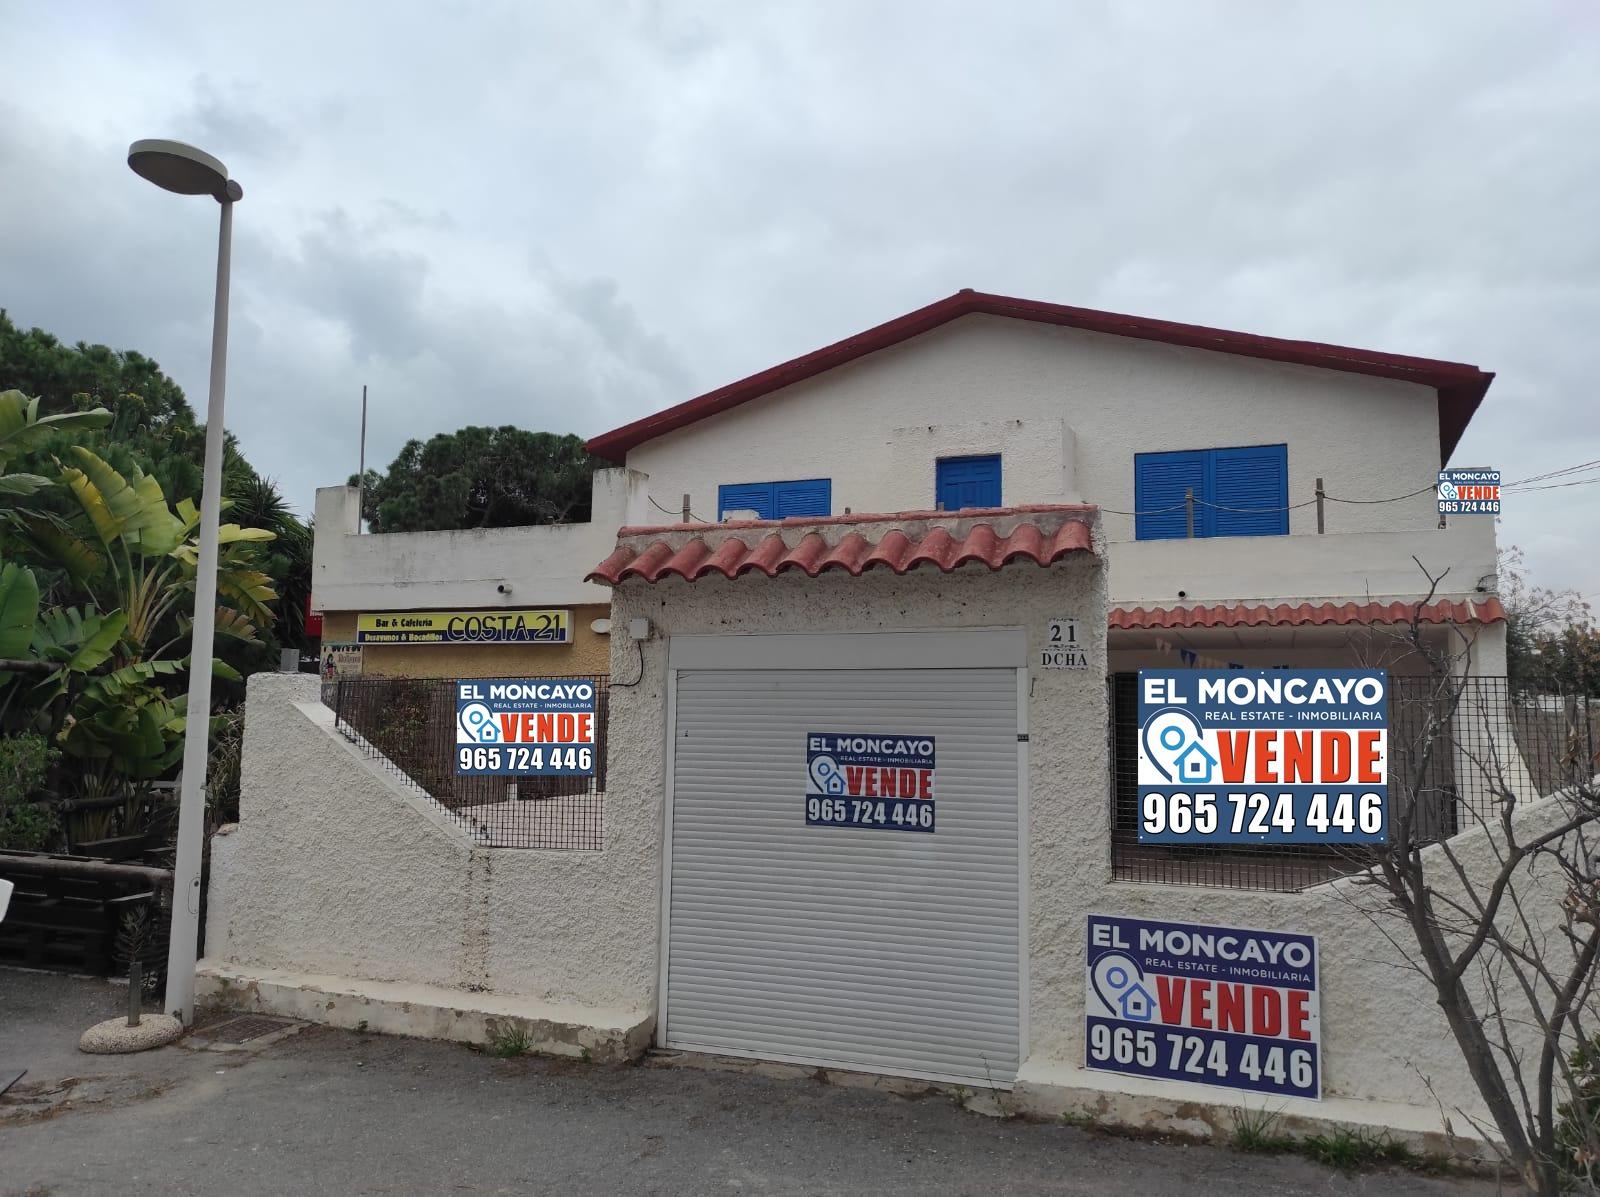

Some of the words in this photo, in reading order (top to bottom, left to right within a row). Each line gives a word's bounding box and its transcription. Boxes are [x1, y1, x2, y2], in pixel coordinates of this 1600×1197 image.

[1458, 486, 1499, 500] VENDE
[1440, 502, 1458, 512] 965
[1460, 502, 1477, 512] 724
[1480, 502, 1499, 512] 446
[376, 618, 388, 627] Bar
[392, 618, 398, 627] &
[447, 615, 529, 641] COSTA
[534, 614, 560, 640] 21
[1050, 624, 1076, 642] 21
[1041, 652, 1088, 666] DCHA
[460, 685, 484, 699] EL
[490, 684, 592, 700] MONCAYO
[1144, 678, 1187, 704] EL
[1198, 677, 1383, 705] MONCAYO
[500, 713, 592, 743] VENDE
[1205, 712, 1236, 720] REAL
[1241, 712, 1284, 720] ESTATE
[1298, 712, 1382, 720] INMOBILIARIA
[460, 747, 501, 770] 965
[507, 747, 544, 770] 724
[550, 747, 592, 770] 446
[810, 737, 832, 752] EL
[837, 738, 934, 756] MONCAYO
[1216, 730, 1381, 783] VENDE
[846, 766, 932, 799] VENDE
[808, 798, 846, 822] 965
[852, 801, 886, 824] 724
[892, 804, 932, 827] 446
[1143, 792, 1218, 834] 965
[1228, 792, 1295, 834] 724
[1306, 792, 1382, 834] 446
[1092, 924, 1130, 949] EL
[1139, 928, 1311, 968] MONCAYO
[1146, 958, 1174, 968] REAL
[1178, 961, 1218, 973] ESTATE
[1230, 967, 1310, 982] INMOBILIARIA
[1156, 976, 1311, 1041] VENDE
[1091, 1024, 1157, 1067] 965
[1167, 1034, 1228, 1077] 724
[1239, 1043, 1313, 1088] 446
